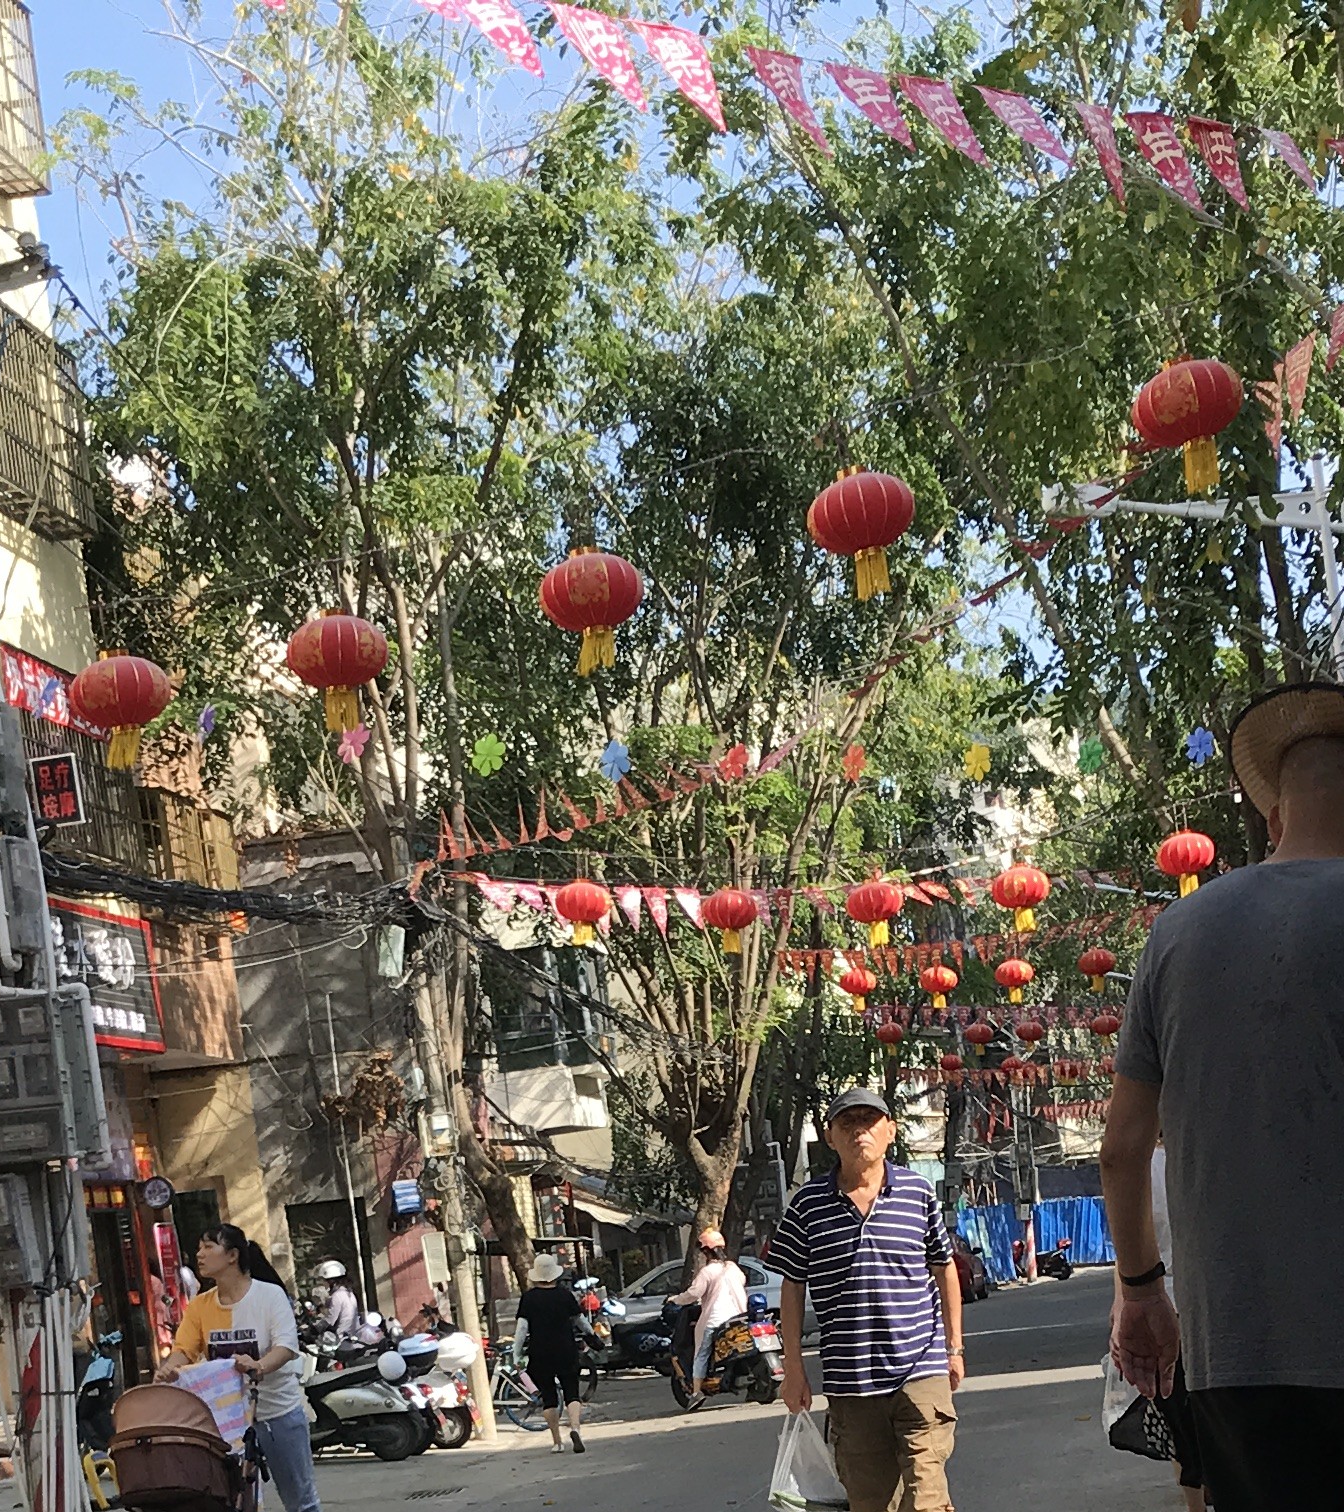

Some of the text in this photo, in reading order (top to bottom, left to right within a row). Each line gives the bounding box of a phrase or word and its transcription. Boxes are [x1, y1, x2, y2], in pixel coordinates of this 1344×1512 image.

[844, 75, 892, 113] 年
[1142, 128, 1184, 170] 年
[1199, 129, 1234, 166] 快
[38, 761, 70, 791] 足疗
[42, 791, 77, 820] 按摩
